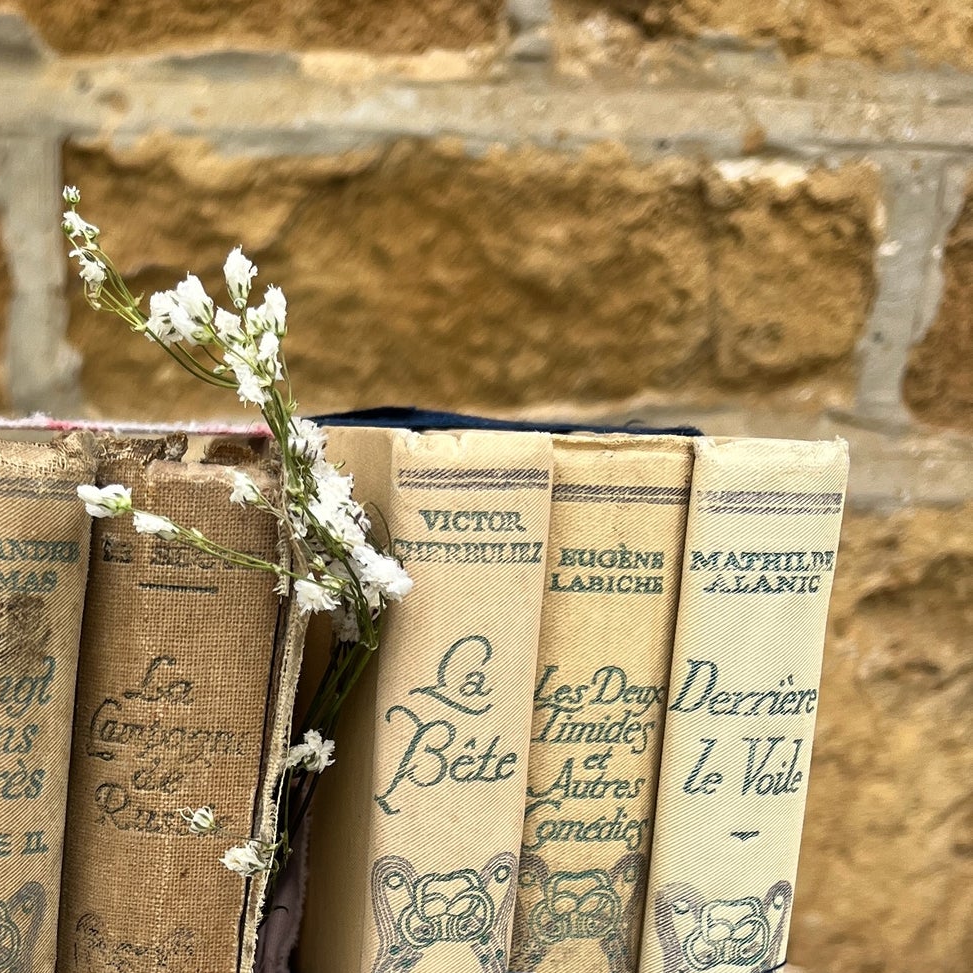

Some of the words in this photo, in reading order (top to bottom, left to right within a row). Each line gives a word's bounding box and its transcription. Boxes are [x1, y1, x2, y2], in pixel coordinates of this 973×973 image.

[419, 509, 527, 533] VICTOR
[558, 543, 665, 570] EUGÈNE
[690, 550, 835, 572] MATHILDE
[548, 572, 664, 594] LABICHE
[703, 573, 821, 594] ALANIC
[123, 655, 195, 705] La
[409, 635, 492, 716] La
[534, 665, 588, 713] Les
[589, 665, 664, 717] Deux
[670, 659, 818, 717] Derrière
[532, 702, 655, 755] Timides
[374, 705, 518, 816] Bête
[526, 757, 646, 799] Autres
[583, 746, 613, 770] et
[684, 738, 723, 796] le
[739, 736, 803, 796] Voile
[522, 798, 649, 851] Comédies
